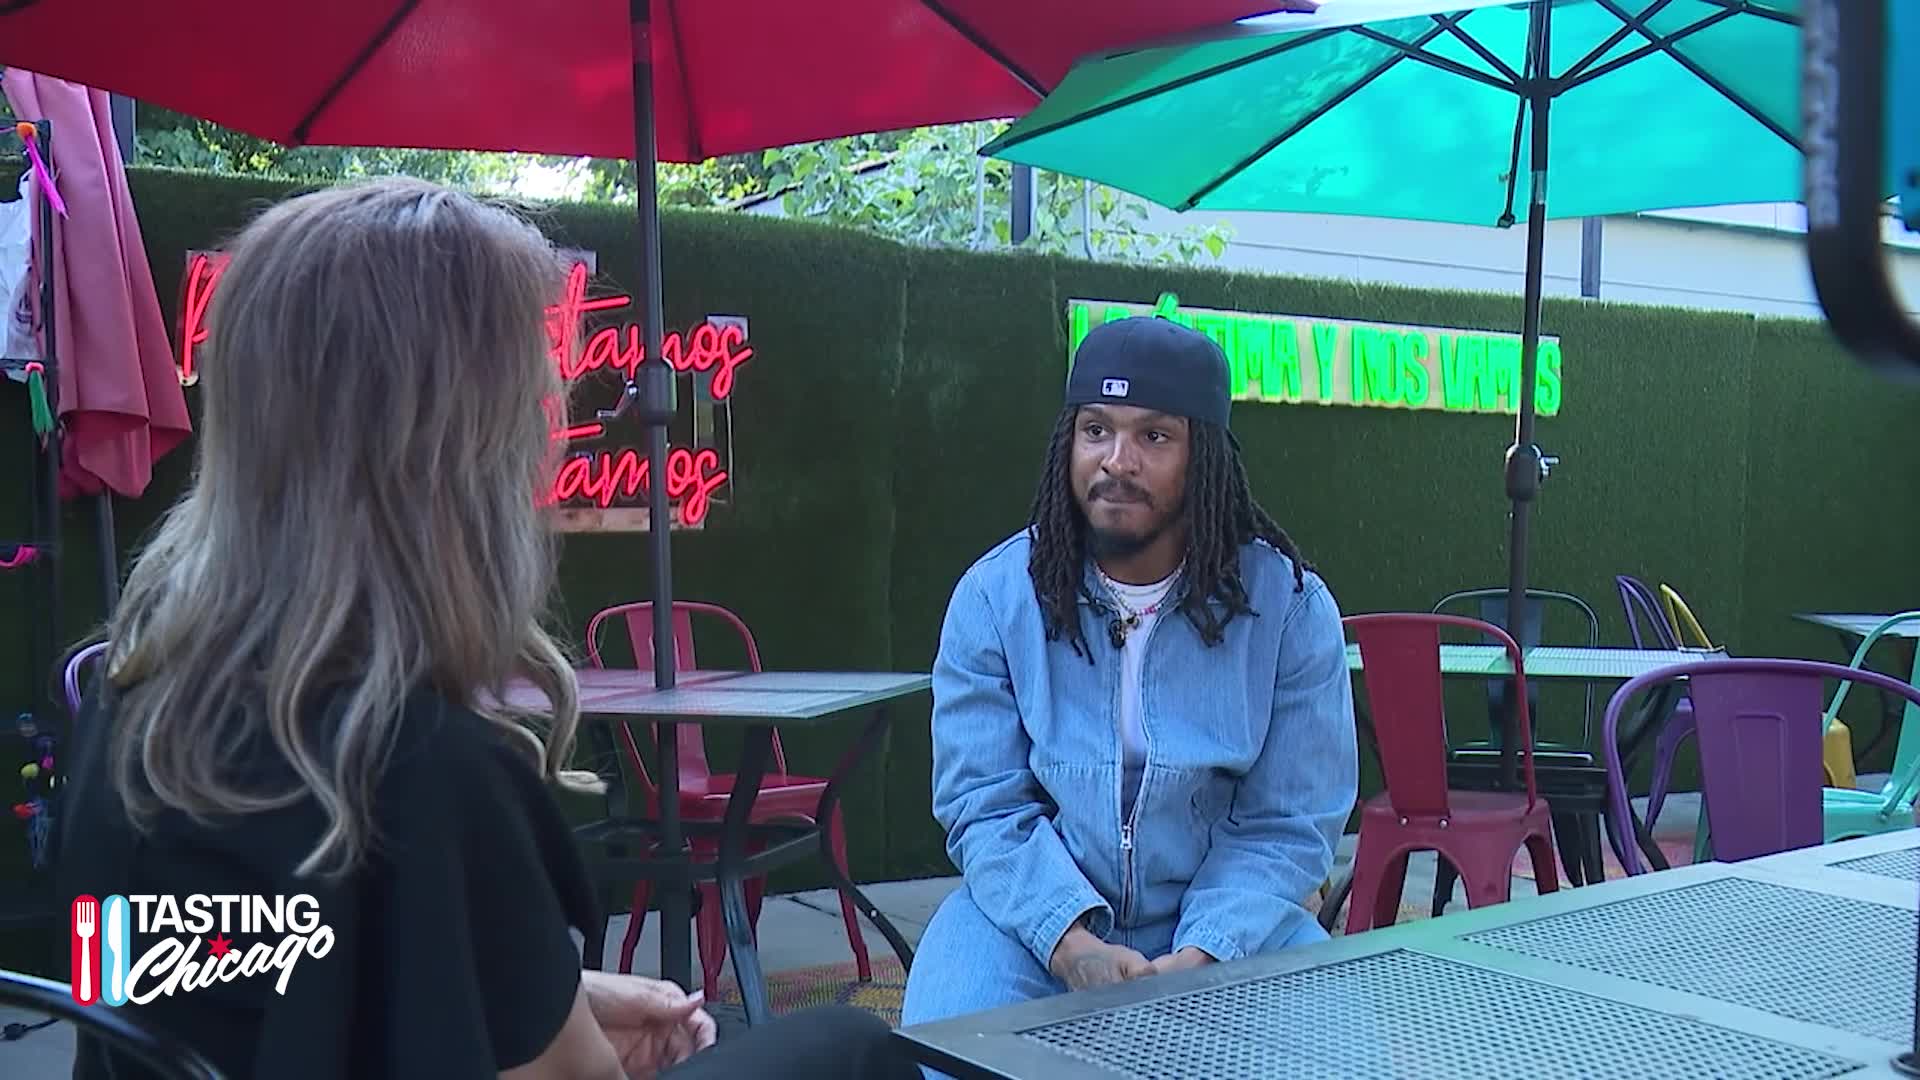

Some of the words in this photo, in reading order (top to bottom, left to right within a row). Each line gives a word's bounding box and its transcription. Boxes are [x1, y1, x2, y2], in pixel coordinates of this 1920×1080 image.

[1312, 322, 1338, 404] Y
[1351, 326, 1430, 408] NOS
[1439, 333, 1562, 415] VAMS
